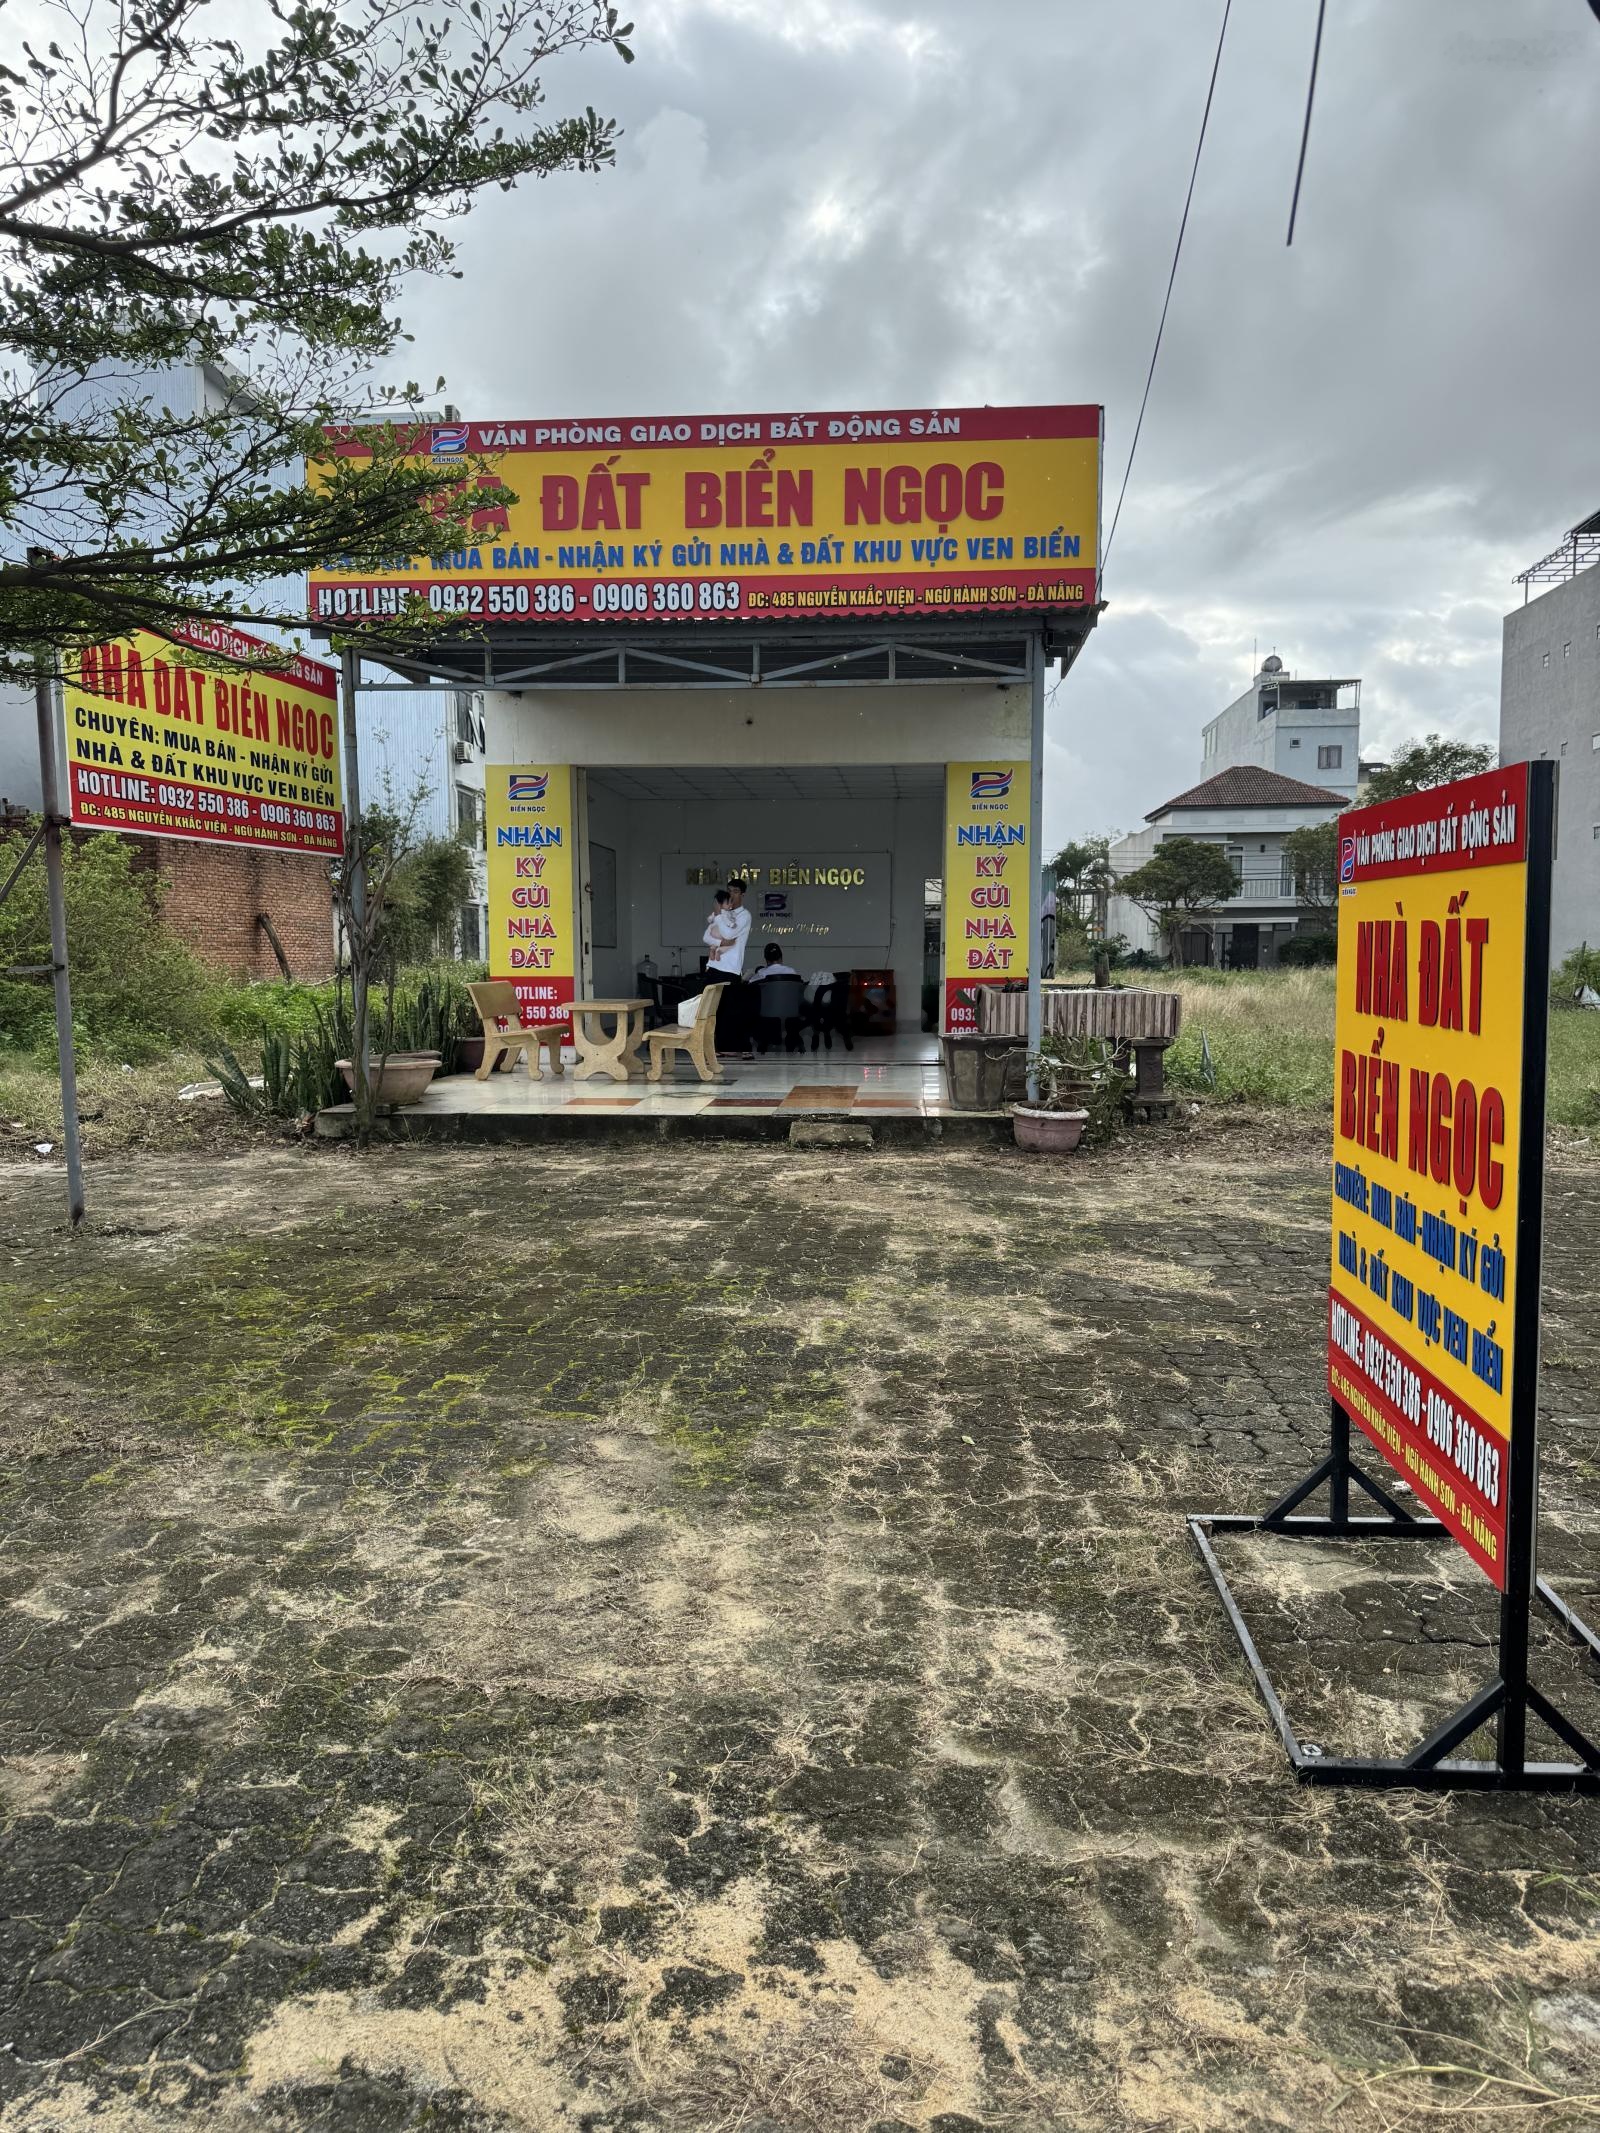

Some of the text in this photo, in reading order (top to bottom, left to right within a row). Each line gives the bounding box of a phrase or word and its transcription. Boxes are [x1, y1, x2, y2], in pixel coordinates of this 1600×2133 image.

[478, 411, 961, 447] VĂN PHÒNG GIAO DỊCH BẤT ĐỘNG SẢN
[540, 455, 651, 531] ĐẤT
[685, 448, 814, 529] BIỂN
[844, 461, 1005, 534] NGỌC
[493, 542, 540, 570] BÁN
[558, 541, 624, 573] NHẬN
[633, 540, 663, 568] KÝ
[672, 536, 711, 567] GỬI
[720, 538, 771, 565] NHÀ
[778, 544, 794, 565] &
[800, 533, 845, 564] ĐẤT
[854, 540, 901, 563] KHU
[912, 536, 958, 568] VỰC
[966, 537, 1014, 561] VEN
[1024, 525, 1081, 559] BIỂN
[429, 584, 483, 614] 0932
[488, 585, 529, 614] 550
[535, 583, 575, 612] 386
[592, 582, 648, 611] 0906
[653, 582, 695, 611] 360
[698, 581, 740, 610] 863
[748, 590, 769, 608] ĐC:
[772, 590, 795, 607] 485
[797, 584, 848, 607] NGUYỄN
[849, 583, 883, 606] KHẮC
[885, 586, 915, 609] VIỆN
[925, 585, 952, 604] NGŨ
[953, 582, 989, 603] HÀNH
[990, 585, 1017, 603] SƠN
[1027, 581, 1046, 601] ĐÀ
[304, 661, 323, 686] SẢN
[215, 671, 270, 743] BIỂN
[275, 698, 334, 764] NGỌC
[75, 707, 160, 745] CHUYÊN:
[164, 729, 201, 755] MUA
[205, 739, 236, 763] BÁN
[250, 750, 290, 777] NHẬN
[293, 758, 309, 780] KÝ
[311, 762, 333, 785] GỬI
[76, 738, 335, 807] NHÀ & ĐẤT KHU VỰC VEN BIỂN
[77, 768, 156, 804] HOTLINE:
[158, 784, 194, 811] 0932
[198, 791, 225, 815] 550
[227, 797, 249, 820] 386
[260, 804, 291, 827] 0906
[292, 810, 314, 831] 360
[316, 814, 336, 832] 863
[80, 802, 101, 818] ĐC:
[103, 805, 126, 821] 485
[204, 820, 228, 835] VIỆN
[234, 823, 253, 839] NGŨ
[254, 826, 279, 841] HÀNH
[496, 822, 563, 850] NHẬN
[957, 820, 1025, 848] NHẬN
[1356, 789, 1517, 867] VĂN PHÒNG GIAO DỊCH BẤT ĐỘNG SẢN
[515, 853, 547, 878] KÝ
[815, 867, 865, 891] NGỌC
[975, 852, 1008, 877] KÝ
[511, 881, 551, 908] GỬI
[970, 881, 1010, 908] GỬI
[507, 913, 557, 938] NHÀ
[965, 913, 1017, 938] NHÀ
[509, 941, 554, 969] ĐẤT
[967, 942, 1013, 969] ĐẤT
[1355, 890, 1489, 1036] NHÀ ĐẤT
[512, 986, 558, 1000] OTLINE:
[526, 1006, 547, 1020] 550
[1340, 1026, 1505, 1216] BIỂN NGỌC
[1335, 1161, 1369, 1215] CHUYÊN:
[1371, 1181, 1392, 1231] MUA
[1394, 1191, 1417, 1246] BÁN
[1459, 1227, 1478, 1284] KÝ
[1480, 1233, 1505, 1304] GỬI
[1339, 1230, 1504, 1396] NHÀ & ĐẤT KHU VỰC VEN BIỂN
[1331, 1298, 1500, 1507] HOTLINE: 0932 550 386 0906 360 863
[1419, 1459, 1439, 1498] HÀNH
[1440, 1477, 1456, 1516] SƠN
[1461, 1500, 1472, 1536] ĐÀ
